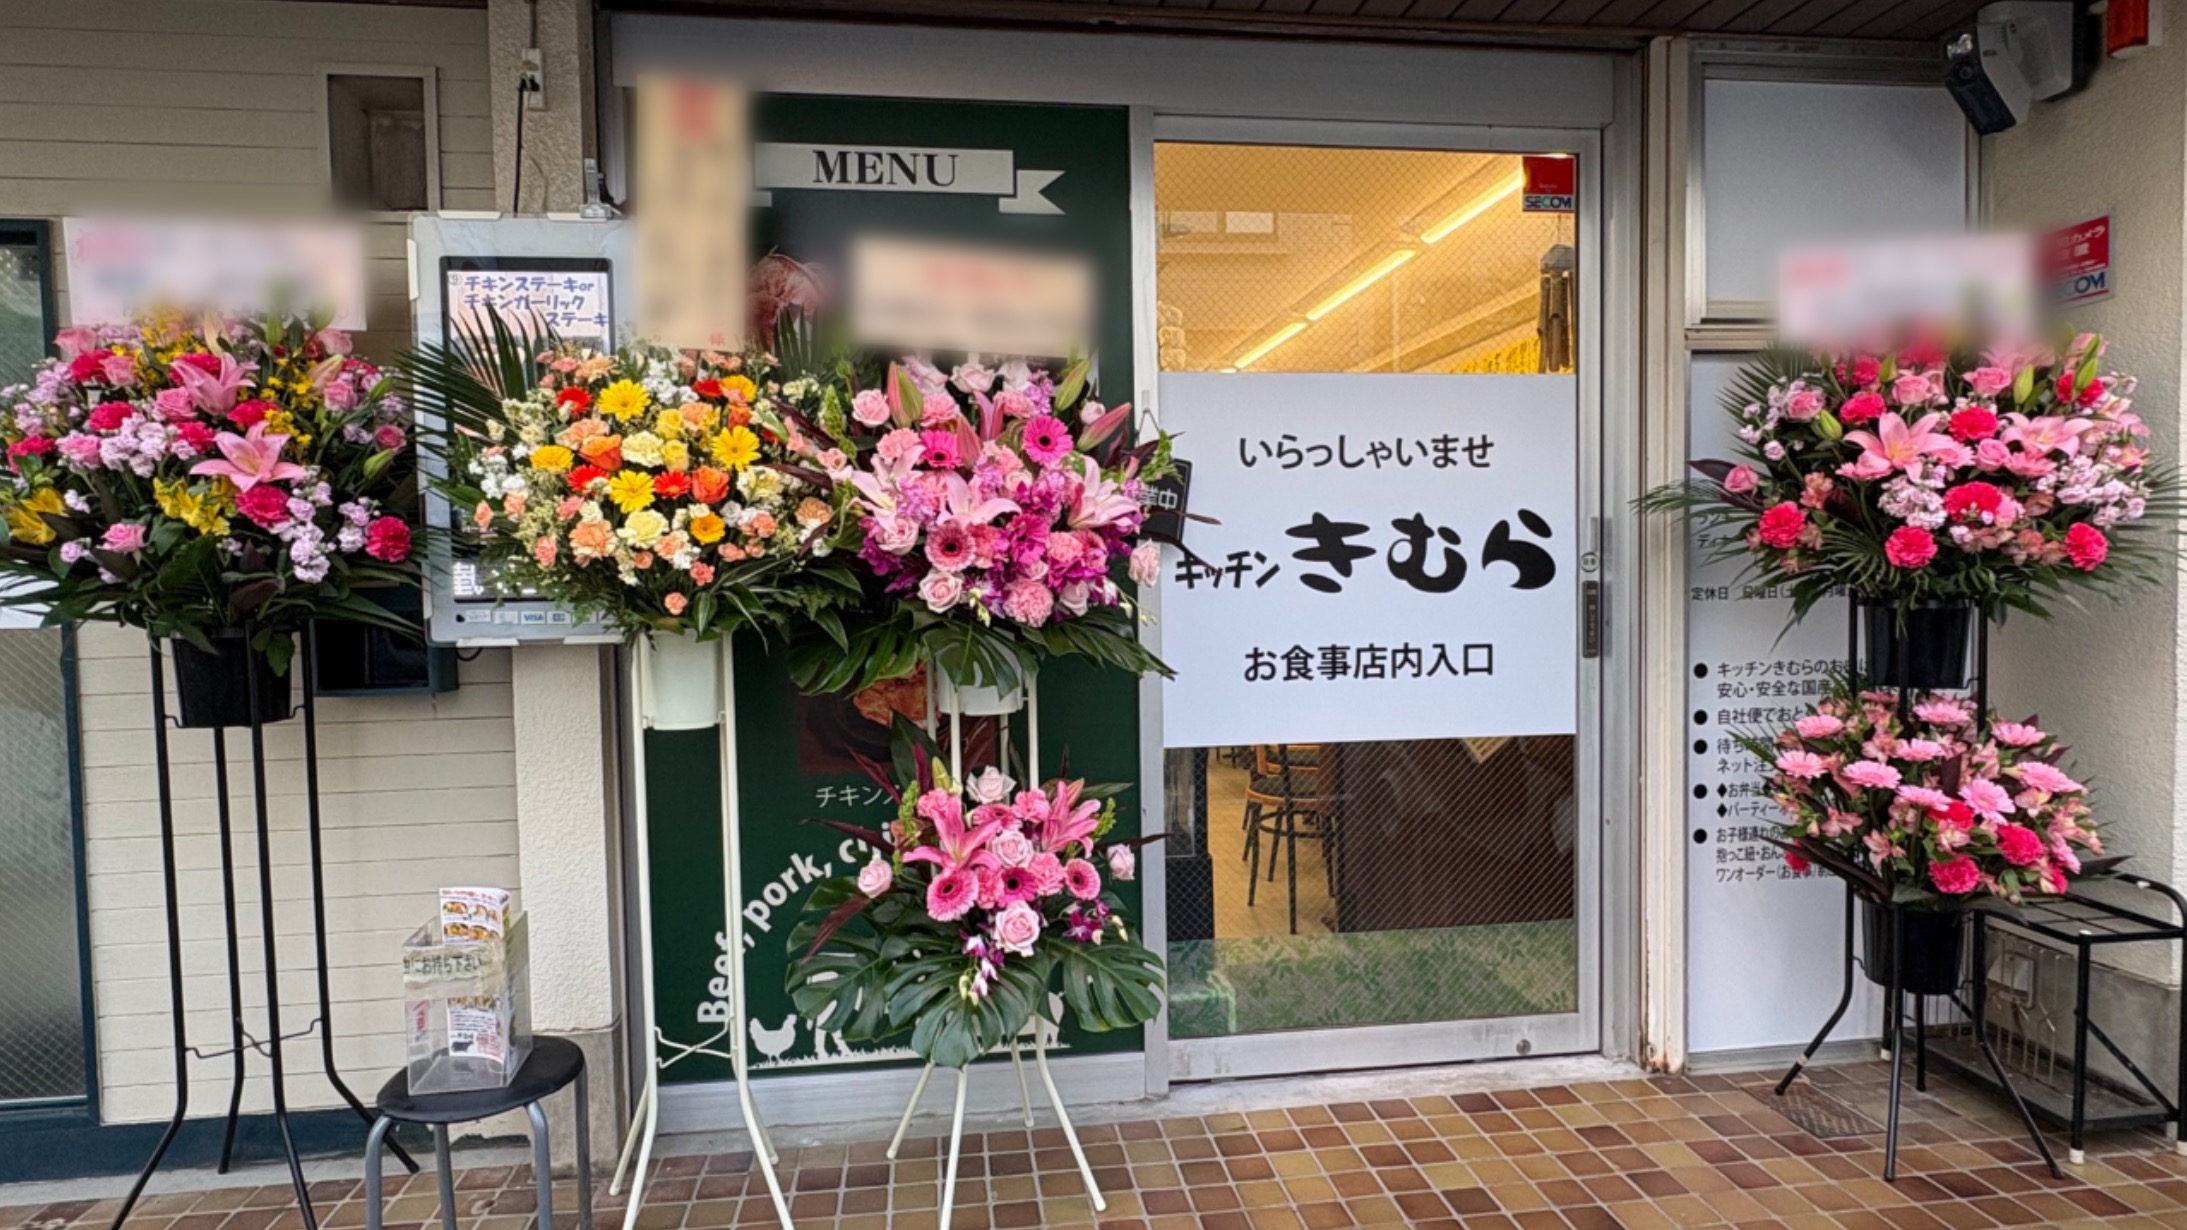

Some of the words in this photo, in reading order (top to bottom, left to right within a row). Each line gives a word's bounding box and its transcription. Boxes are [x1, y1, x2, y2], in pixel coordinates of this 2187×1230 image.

[812, 150, 959, 187] MENU
[1525, 195, 1572, 209] SECOM
[464, 276, 595, 292] チキンステーキor
[464, 294, 585, 311] チキンガーリック
[546, 312, 608, 328] ステーキ
[1239, 433, 1495, 470] いらっしゃいませ
[1691, 586, 1729, 601] 定休日
[1243, 643, 1494, 682] お食事店内入口
[742, 853, 832, 933] pork,
